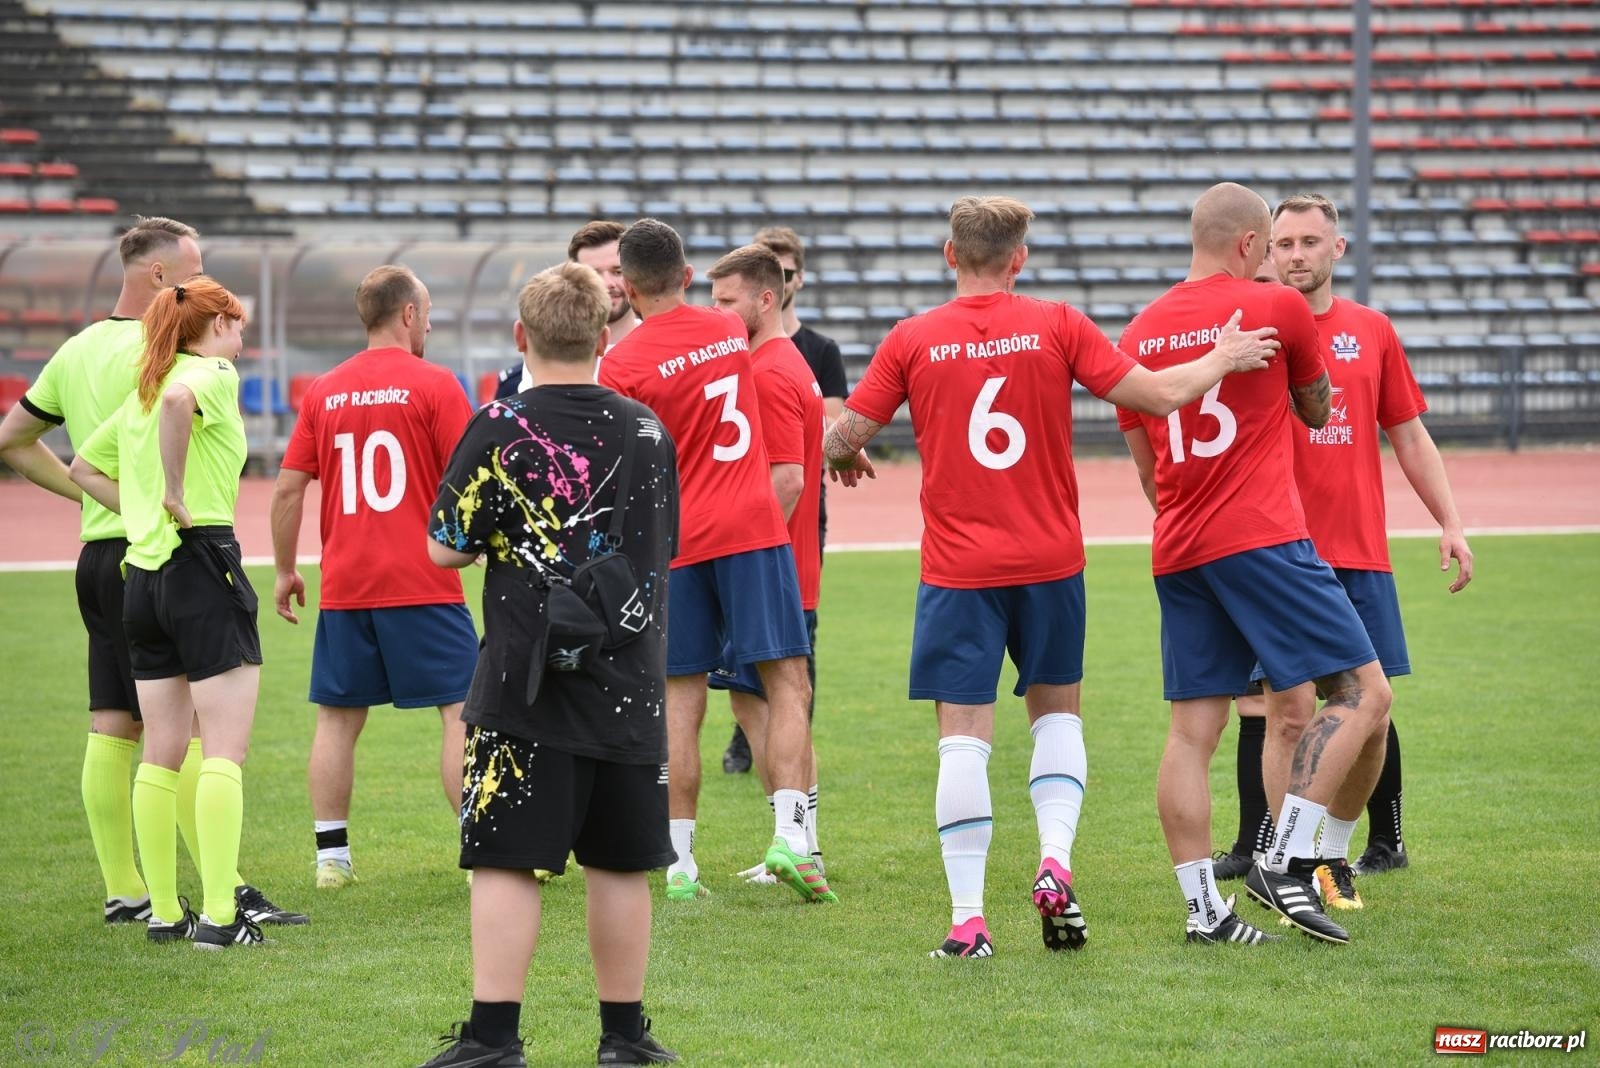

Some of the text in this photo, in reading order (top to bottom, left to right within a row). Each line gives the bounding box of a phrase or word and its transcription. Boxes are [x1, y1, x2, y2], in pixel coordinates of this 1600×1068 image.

[929, 333, 1041, 362] KPP RACIBÓRZ
[1138, 323, 1240, 356] KPP RACIBÓ
[657, 356, 686, 379] KPP
[325, 385, 410, 412] KPP RACIBÓRZ
[703, 373, 751, 462] 3
[968, 376, 1027, 470] 6
[1309, 435, 1353, 445] FELGI.PL
[334, 430, 407, 515] 10
[793, 801, 806, 829] NIKE
